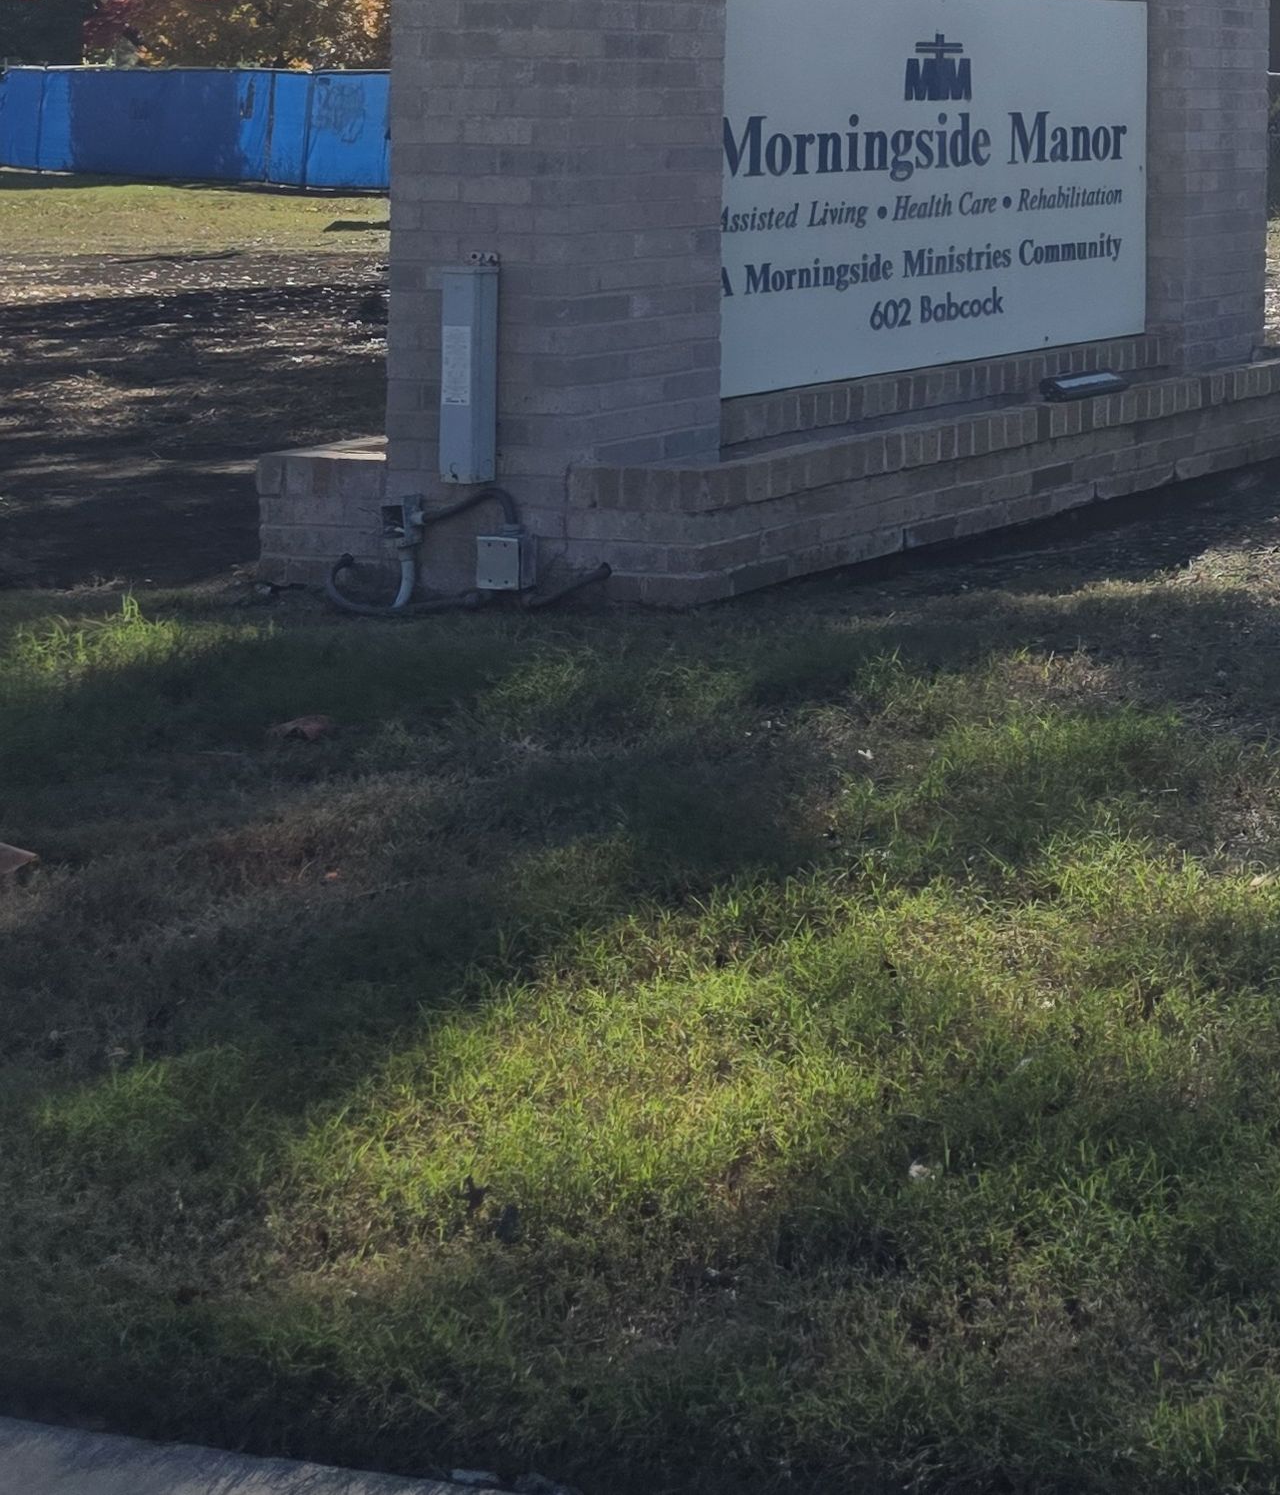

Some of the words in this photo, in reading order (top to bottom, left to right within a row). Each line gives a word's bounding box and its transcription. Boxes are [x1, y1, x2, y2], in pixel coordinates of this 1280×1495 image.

[722, 112, 992, 182] Morningside
[1006, 110, 1128, 165] Manor
[720, 202, 799, 233] Assisted
[807, 200, 869, 228] Living
[892, 193, 953, 221] Health
[958, 191, 998, 216] Care
[1017, 185, 1123, 212] Rehabilitation
[720, 266, 734, 297] A
[744, 253, 894, 296] Morningside
[902, 242, 1012, 278] Ministries
[1018, 232, 1123, 266] Community
[869, 297, 912, 331] 602
[919, 285, 1004, 324] Babcock
